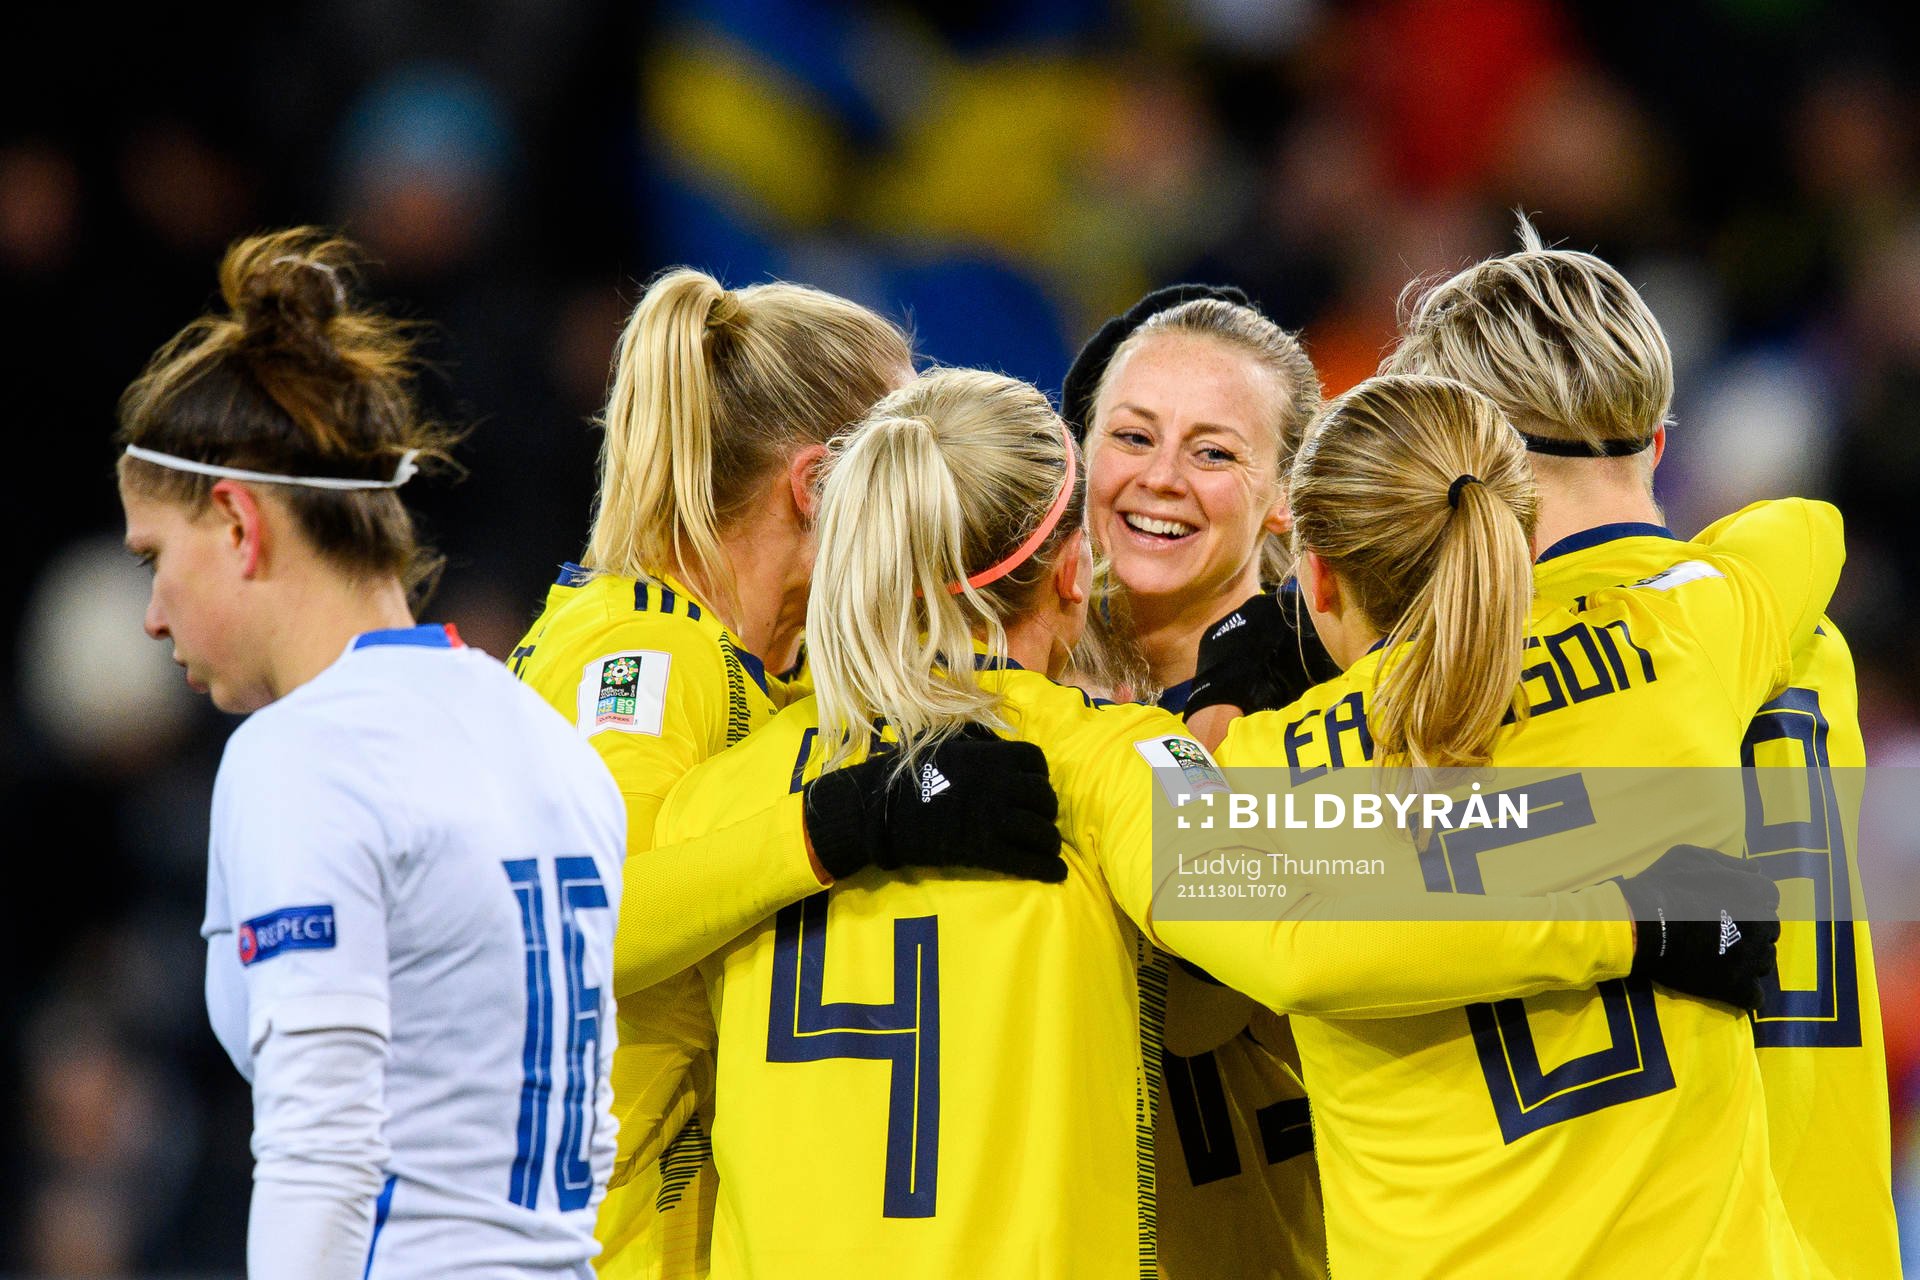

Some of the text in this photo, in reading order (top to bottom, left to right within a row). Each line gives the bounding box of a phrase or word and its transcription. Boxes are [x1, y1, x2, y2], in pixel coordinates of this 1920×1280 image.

[921, 763, 933, 803] adidas
[500, 856, 610, 1213] 16
[766, 886, 939, 1220] 4
